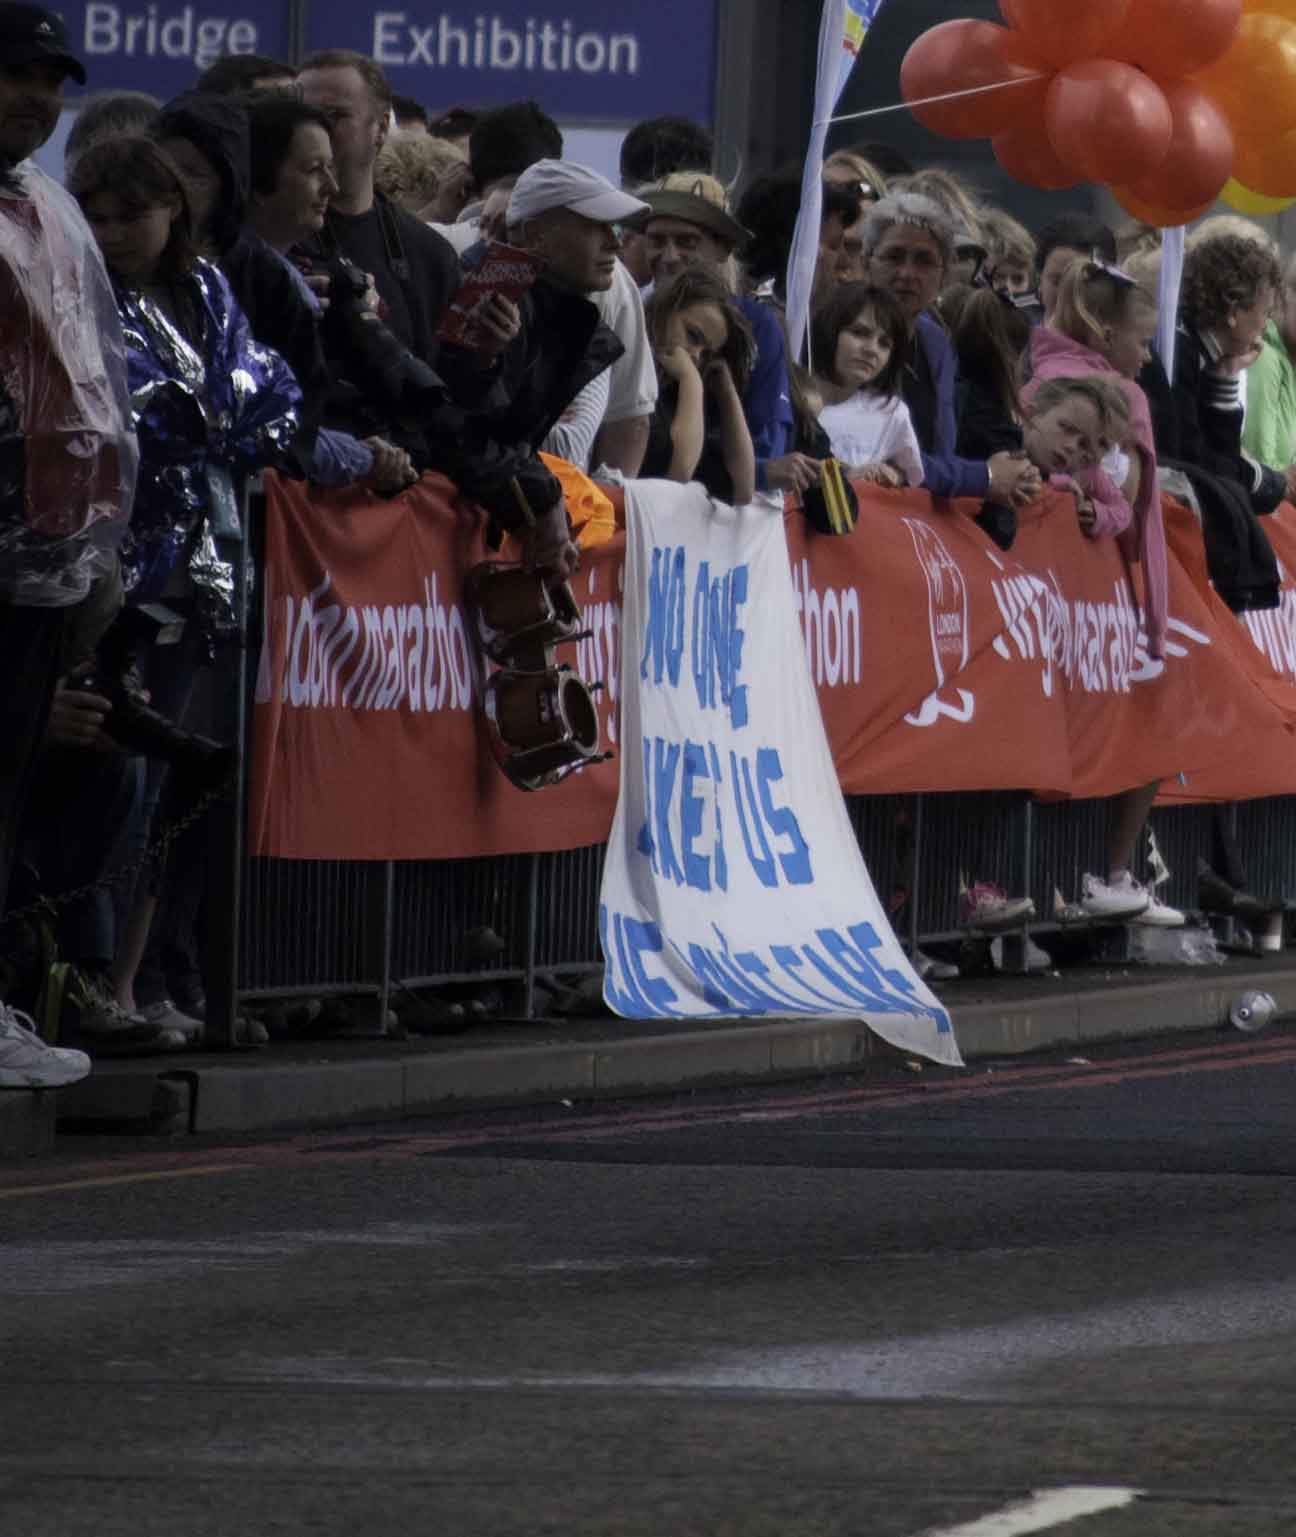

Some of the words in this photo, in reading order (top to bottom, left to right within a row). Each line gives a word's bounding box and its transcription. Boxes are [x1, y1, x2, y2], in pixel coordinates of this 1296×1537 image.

[83, 0, 259, 72] Bridge
[372, 11, 639, 73] Exhibition
[344, 569, 472, 713] maratho
[640, 545, 686, 689] NO
[691, 561, 749, 730] ONE
[729, 746, 816, 889] US
[768, 920, 951, 1034] CARE
